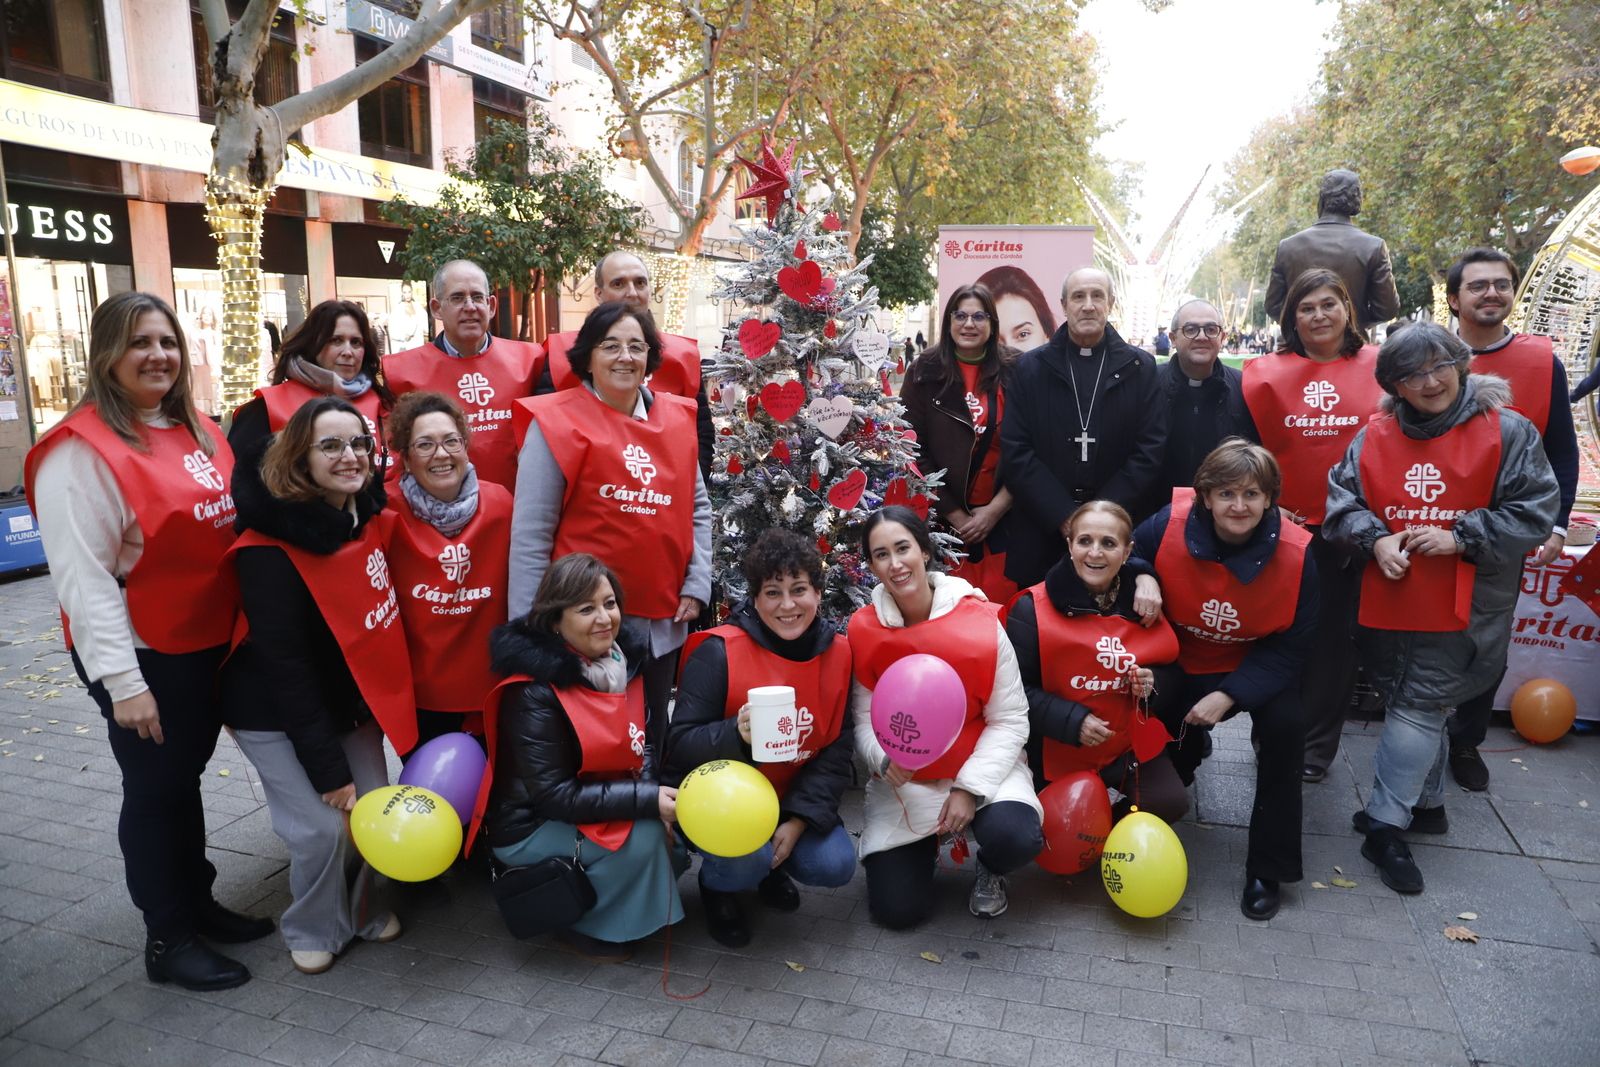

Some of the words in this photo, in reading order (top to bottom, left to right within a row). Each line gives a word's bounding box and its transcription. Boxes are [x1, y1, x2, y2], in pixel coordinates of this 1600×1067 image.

[963, 239, 1023, 252] Cáritas
[467, 408, 512, 423] ritas
[1284, 414, 1359, 428] Cáritas
[1302, 429, 1339, 437] Córdoba
[598, 483, 672, 506] Cáritas
[620, 504, 657, 515] Córdoba
[1384, 505, 1467, 520] Cáritas
[5, 530, 41, 543] HYUNDA
[411, 583, 492, 604] Cáritas
[431, 605, 472, 615] Córdoba
[1512, 636, 1565, 650] ORDOBA
[1070, 675, 1122, 691] Cári
